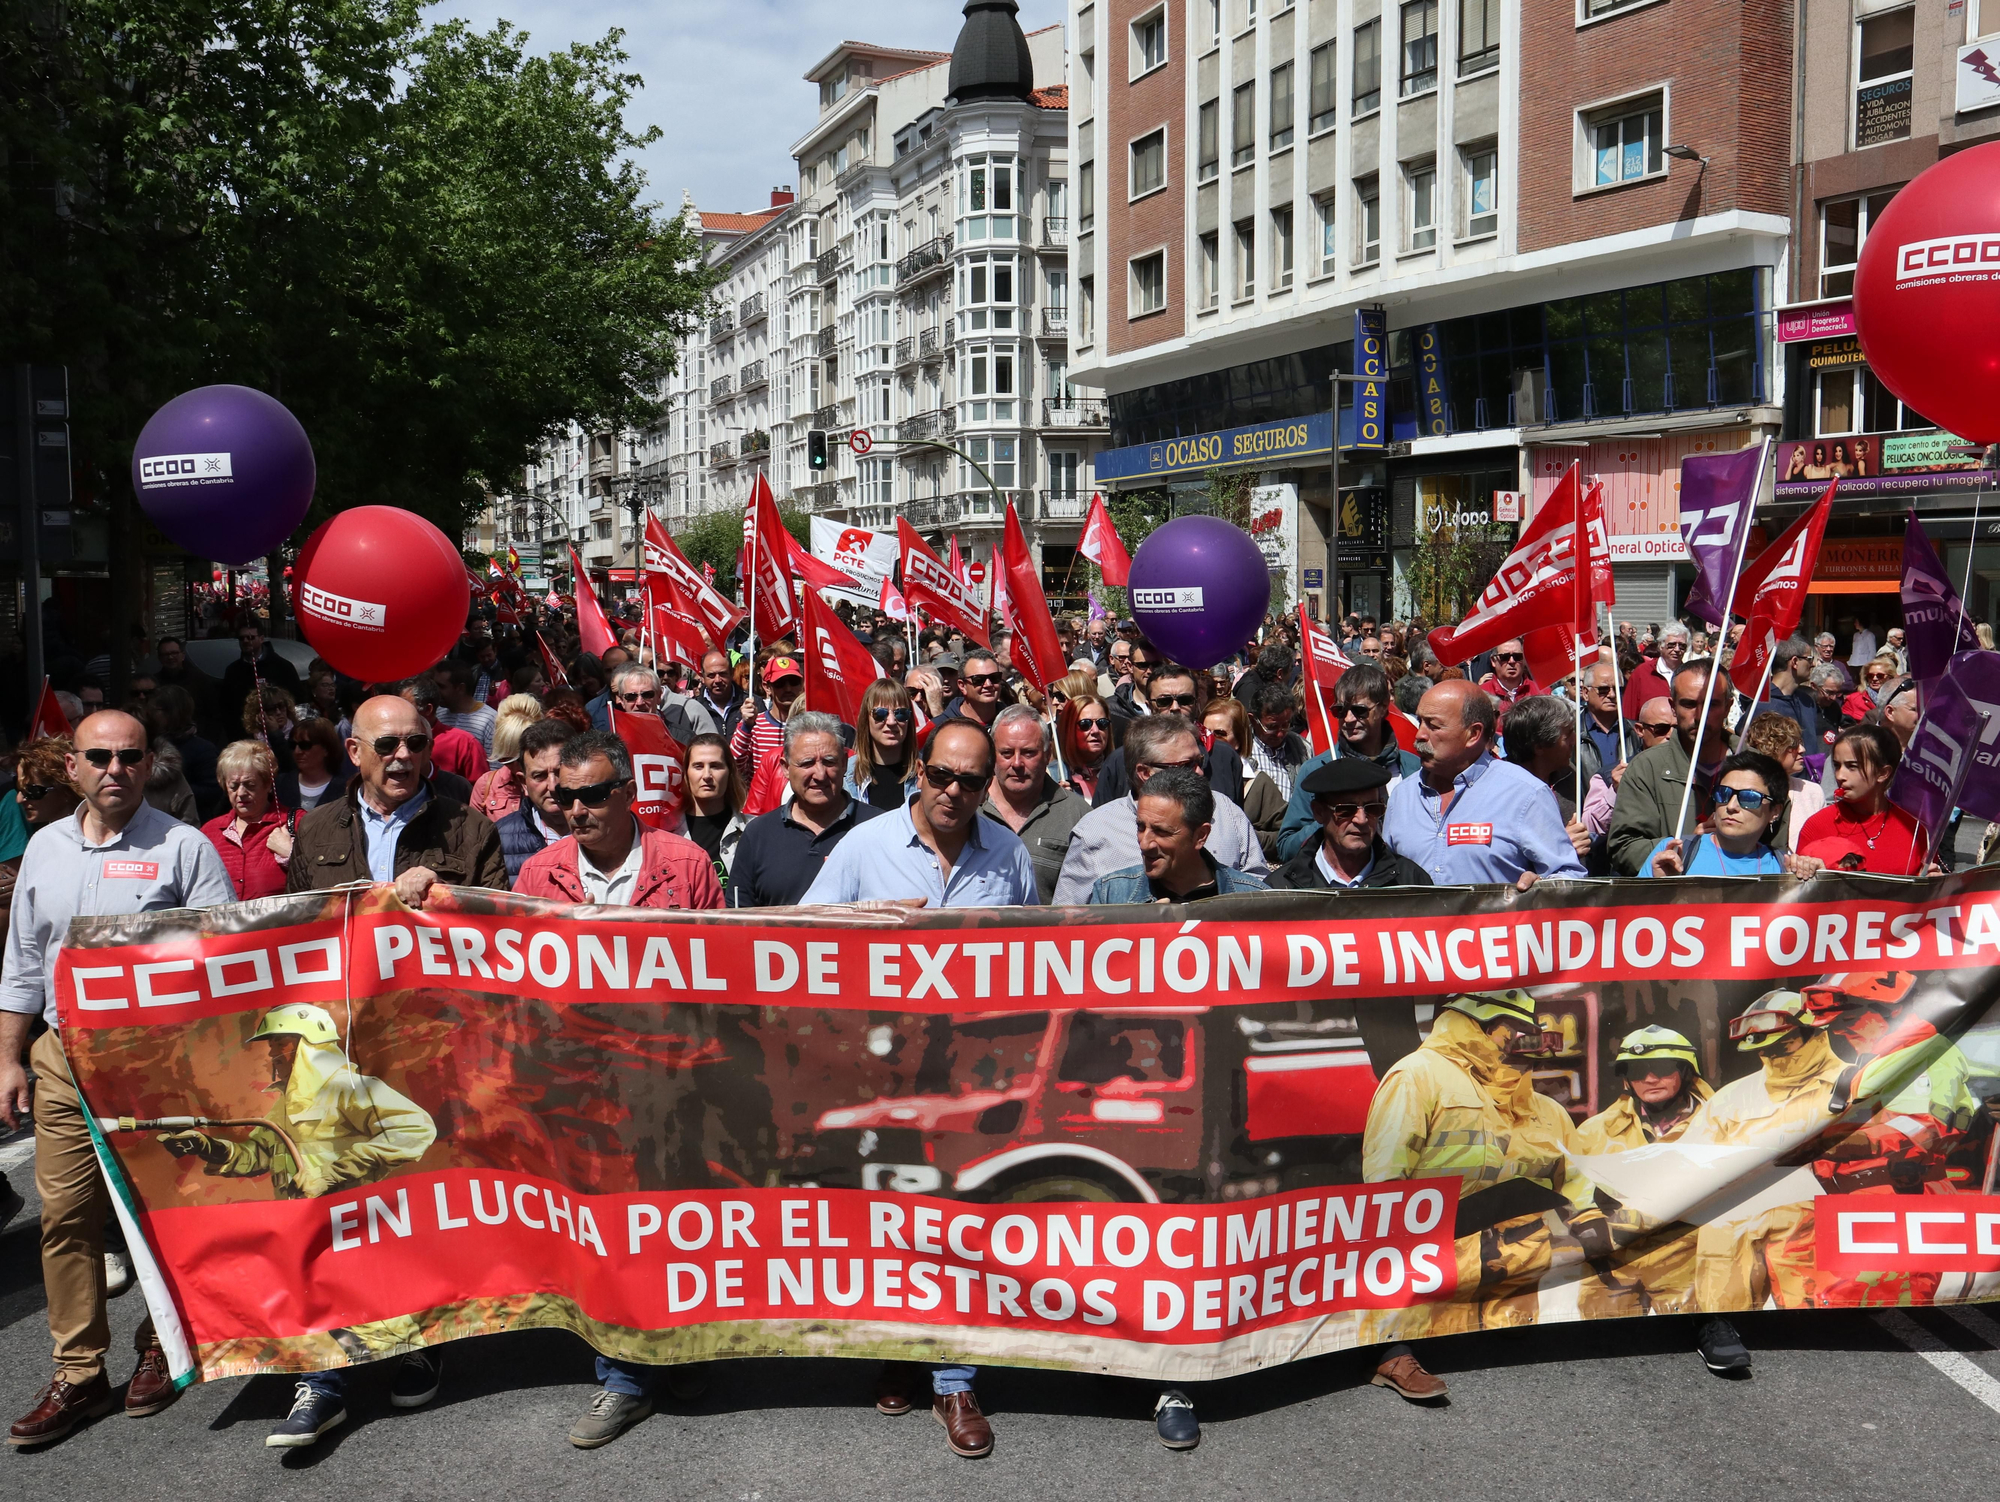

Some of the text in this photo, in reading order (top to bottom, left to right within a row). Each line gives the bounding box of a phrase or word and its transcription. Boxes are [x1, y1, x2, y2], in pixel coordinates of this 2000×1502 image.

[1860, 80, 1911, 102] SEGUROS
[1865, 100, 1911, 118] JUBILACION
[1866, 98, 1885, 109] VIDA
[1865, 108, 1911, 127] ACCIDENTES
[1865, 119, 1911, 136] AUTOMOVIL
[1864, 131, 1894, 145] HOGAR
[1625, 156, 1641, 166] 212
[1625, 164, 1642, 175] 600
[1904, 241, 2000, 271] CCOO
[1895, 276, 1946, 290] comisiones
[1949, 273, 1988, 283] obreras
[1812, 317, 1839, 326] Progreso
[1363, 337, 1380, 439] OCASO
[1166, 424, 1308, 466] OCASO SEGUROS
[1886, 442, 1906, 452] mayor
[1908, 440, 1929, 450] centro
[1931, 439, 1940, 448] de
[1886, 452, 1915, 464] PELUCAS
[143, 459, 196, 477] CCOO
[200, 477, 234, 485] Cantabria
[1776, 482, 1809, 496] sistema
[1881, 474, 1988, 494] recupera tu imagen
[1608, 539, 1685, 556] neral Optica
[833, 552, 865, 569] PCTE
[1824, 565, 1867, 573] TURRONES
[910, 554, 963, 602] CCOO
[302, 588, 351, 617] CCOO
[1135, 592, 1175, 604] CCOO
[322, 615, 343, 626] obreras
[353, 623, 385, 633] Cantabria
[1450, 826, 1490, 836] CCOO
[108, 863, 143, 871] CCOO
[372, 903, 2000, 1001] PERSONAL DE EXTINCIÓN DE INCENDIOS FORESTA
[71, 937, 343, 1011] CCOO
[330, 1178, 1444, 1269] EN LUCHA POR EL RECONOCIMIENTO
[666, 1244, 1443, 1333] DE NUESTROS DERECHOS
